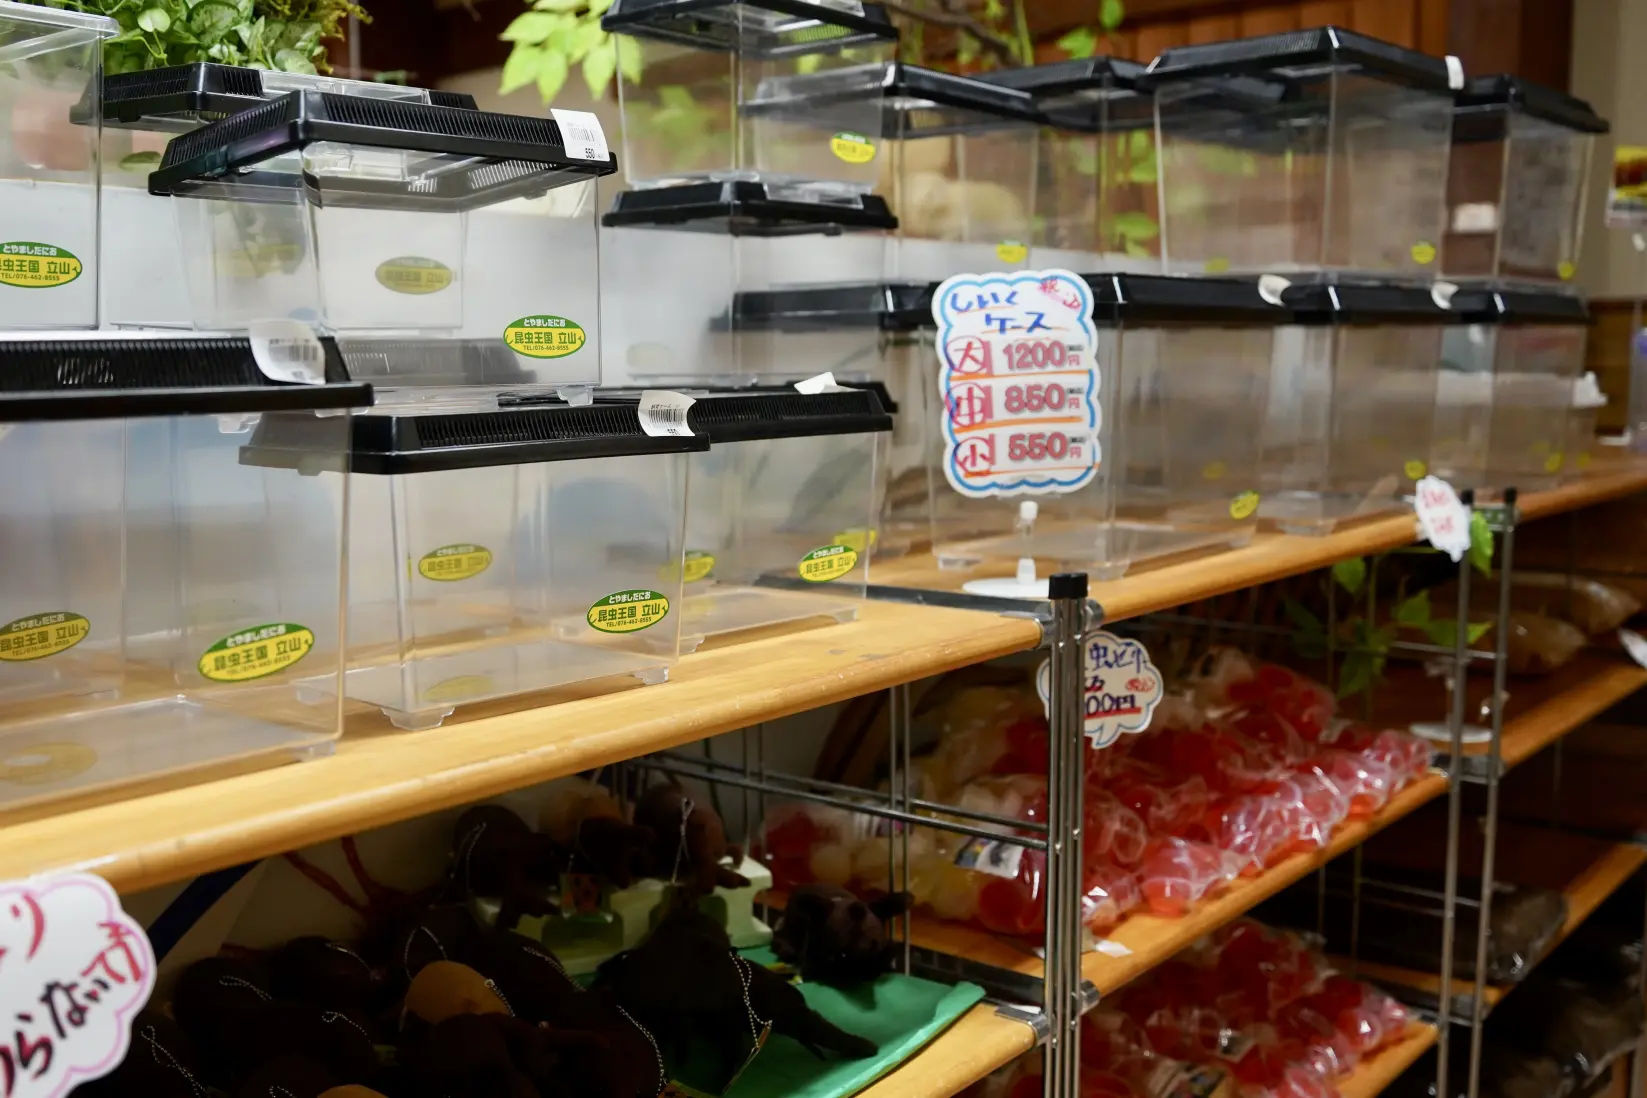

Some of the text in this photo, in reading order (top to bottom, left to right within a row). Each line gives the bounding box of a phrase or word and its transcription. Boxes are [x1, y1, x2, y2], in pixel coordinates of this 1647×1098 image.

[47, 261, 70, 274] 立山
[950, 291, 1018, 312] しいく
[984, 312, 1052, 335] ケース
[514, 331, 577, 344] 昆虫王国 立山
[597, 603, 660, 622] 昆虫王国 立山
[55, 623, 79, 640] 立山
